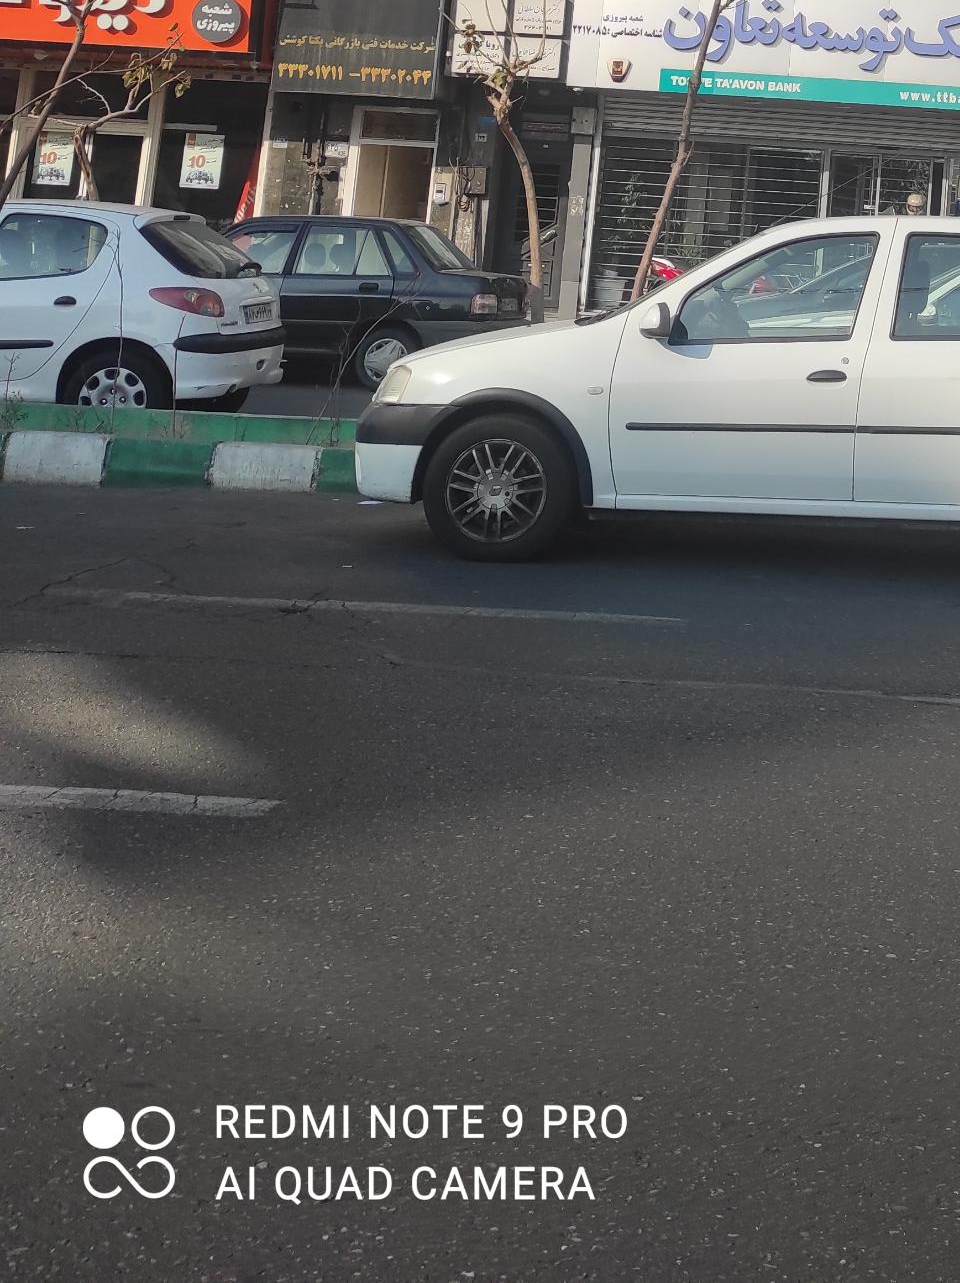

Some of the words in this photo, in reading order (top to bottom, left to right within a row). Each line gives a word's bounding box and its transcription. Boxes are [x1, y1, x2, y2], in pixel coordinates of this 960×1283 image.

[201, 2, 233, 16] شعبه
[197, 17, 235, 34] پیروزی
[629, 15, 644, 23] شعبه
[781, 8, 900, 71] توسعه
[768, 81, 801, 93] BANK
